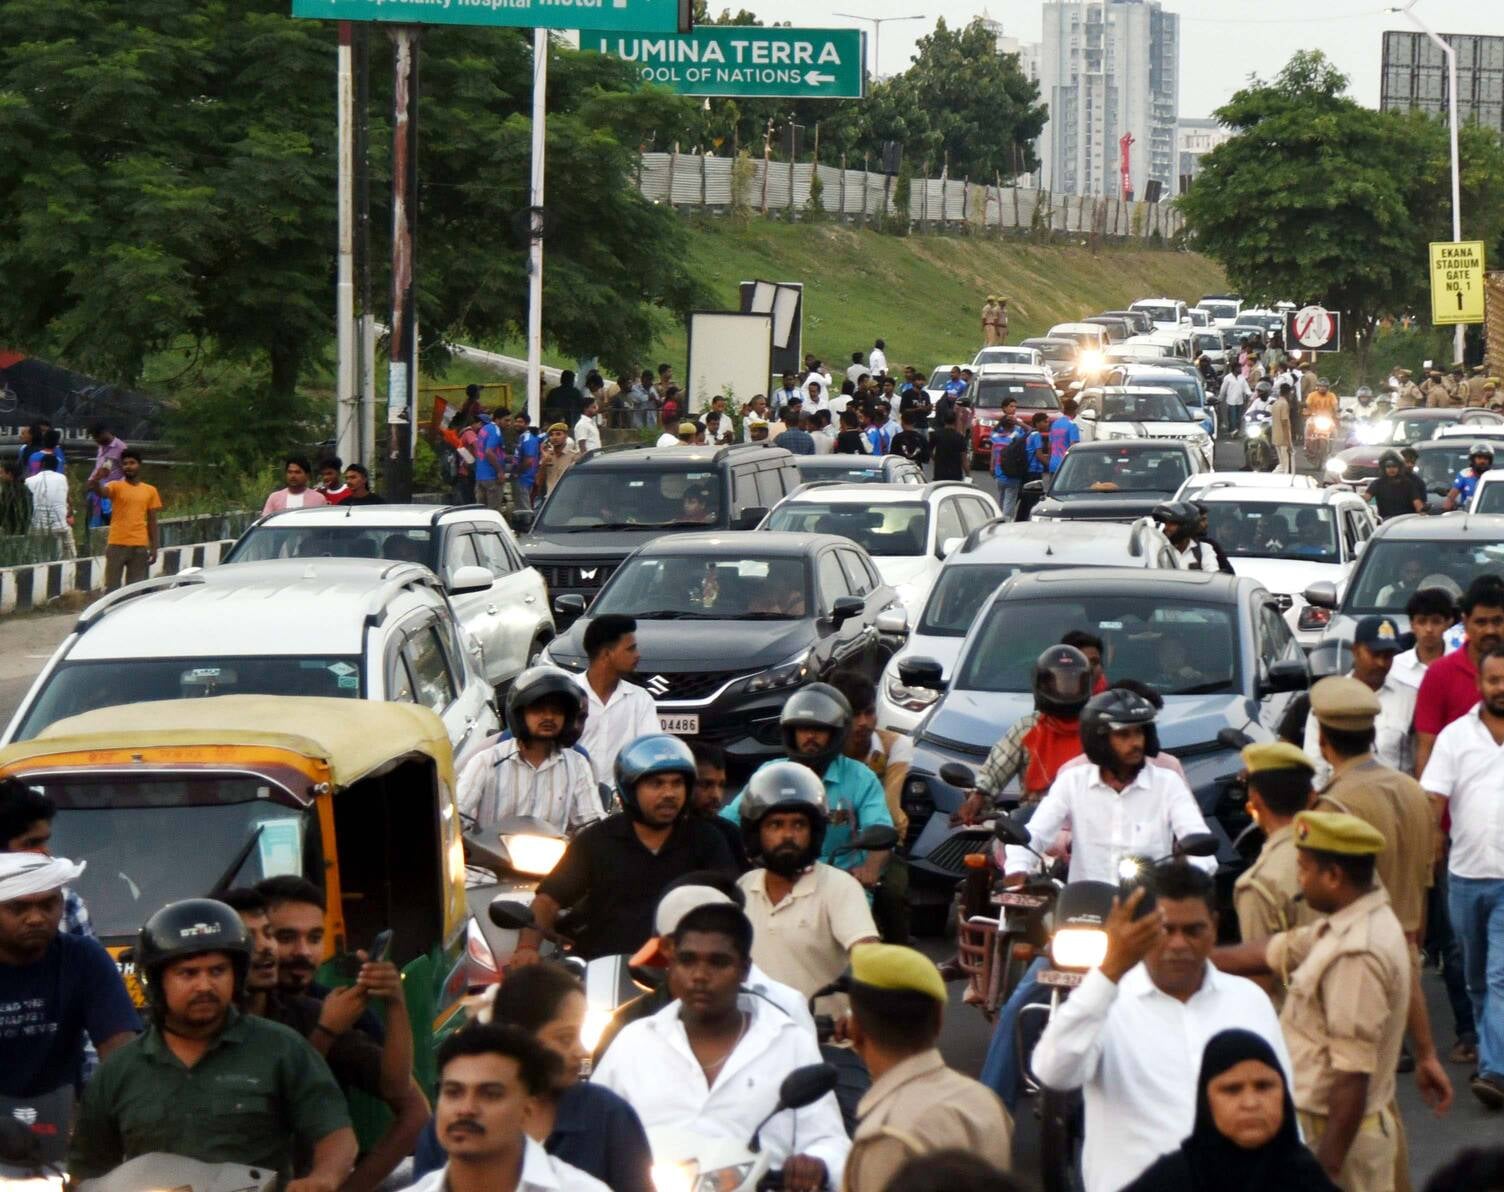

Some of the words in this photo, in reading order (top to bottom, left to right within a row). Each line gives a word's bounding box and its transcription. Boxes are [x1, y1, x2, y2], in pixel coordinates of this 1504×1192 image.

[730, 40, 841, 65] TERRA
[686, 67, 711, 82] OF
[717, 68, 801, 83] NATIONS
[1441, 248, 1473, 258] EKANA
[1436, 259, 1479, 270] STADIUM
[1446, 270, 1471, 280] GATE
[1446, 281, 1462, 291] NO.
[1466, 281, 1471, 291] 1
